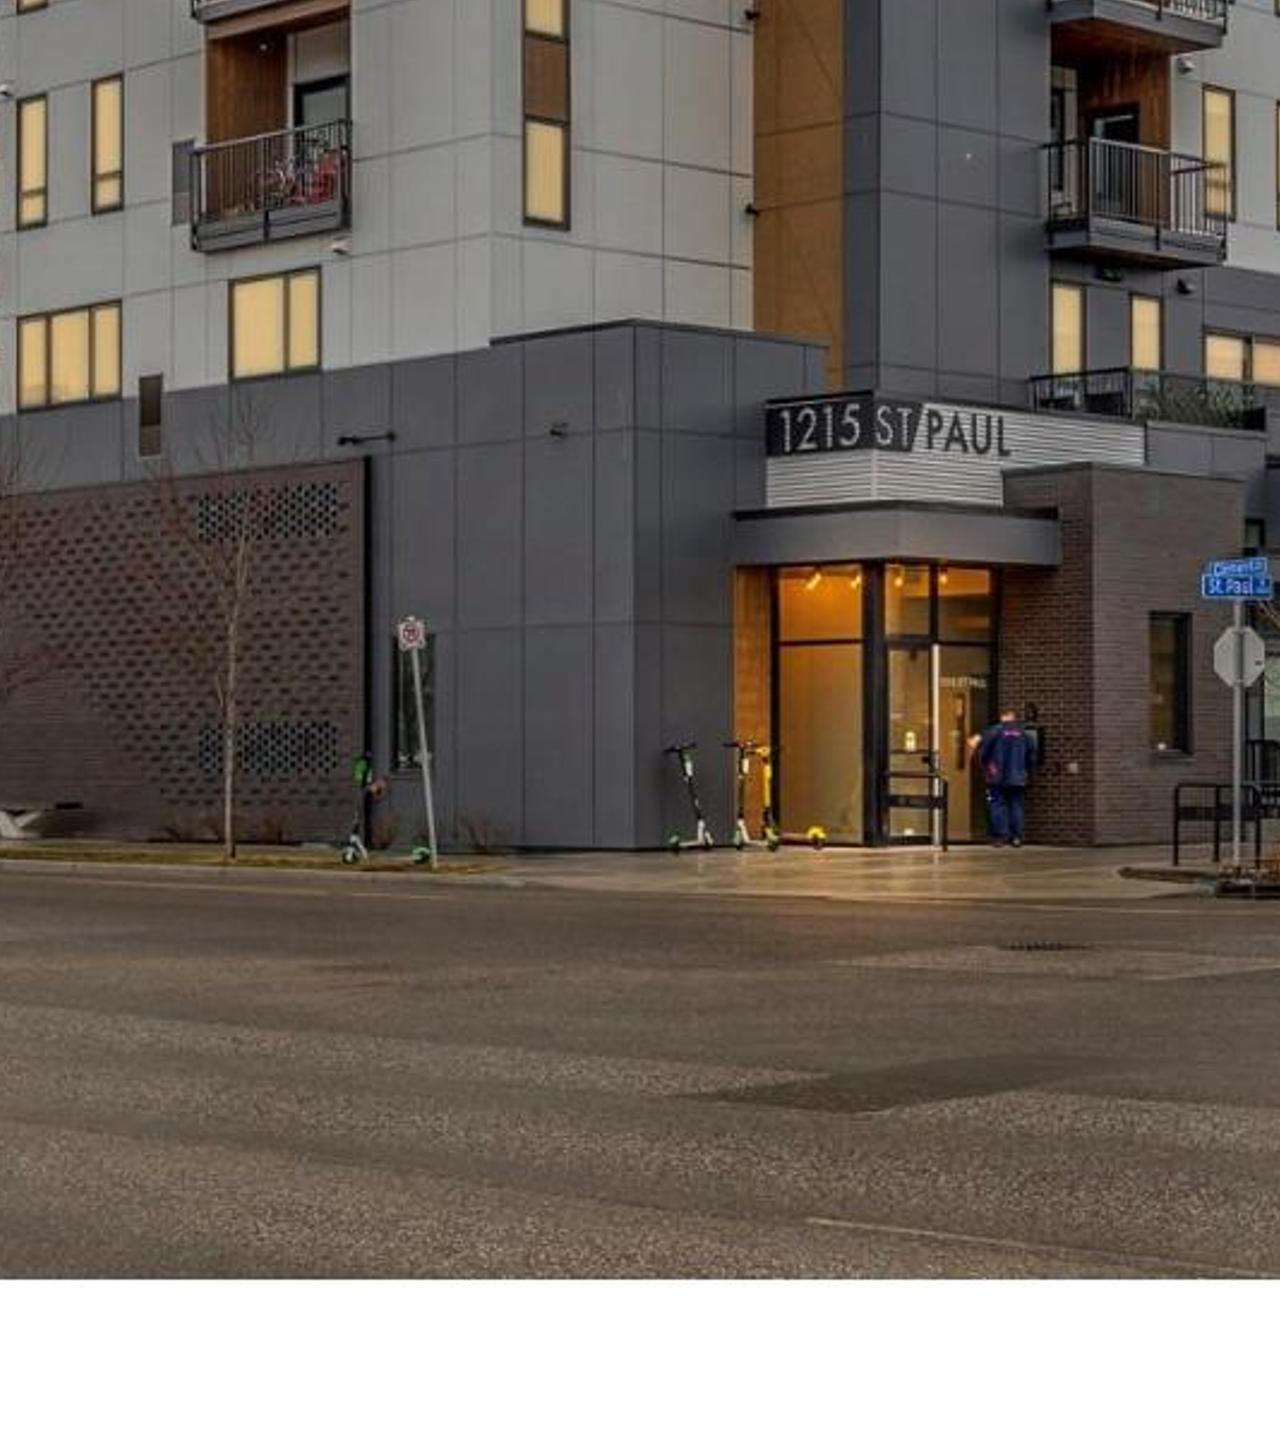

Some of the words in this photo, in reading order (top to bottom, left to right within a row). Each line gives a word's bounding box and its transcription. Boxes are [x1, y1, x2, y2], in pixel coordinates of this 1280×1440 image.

[780, 403, 861, 453] 1215
[874, 405, 913, 448] ST
[925, 409, 1011, 457] PAUL
